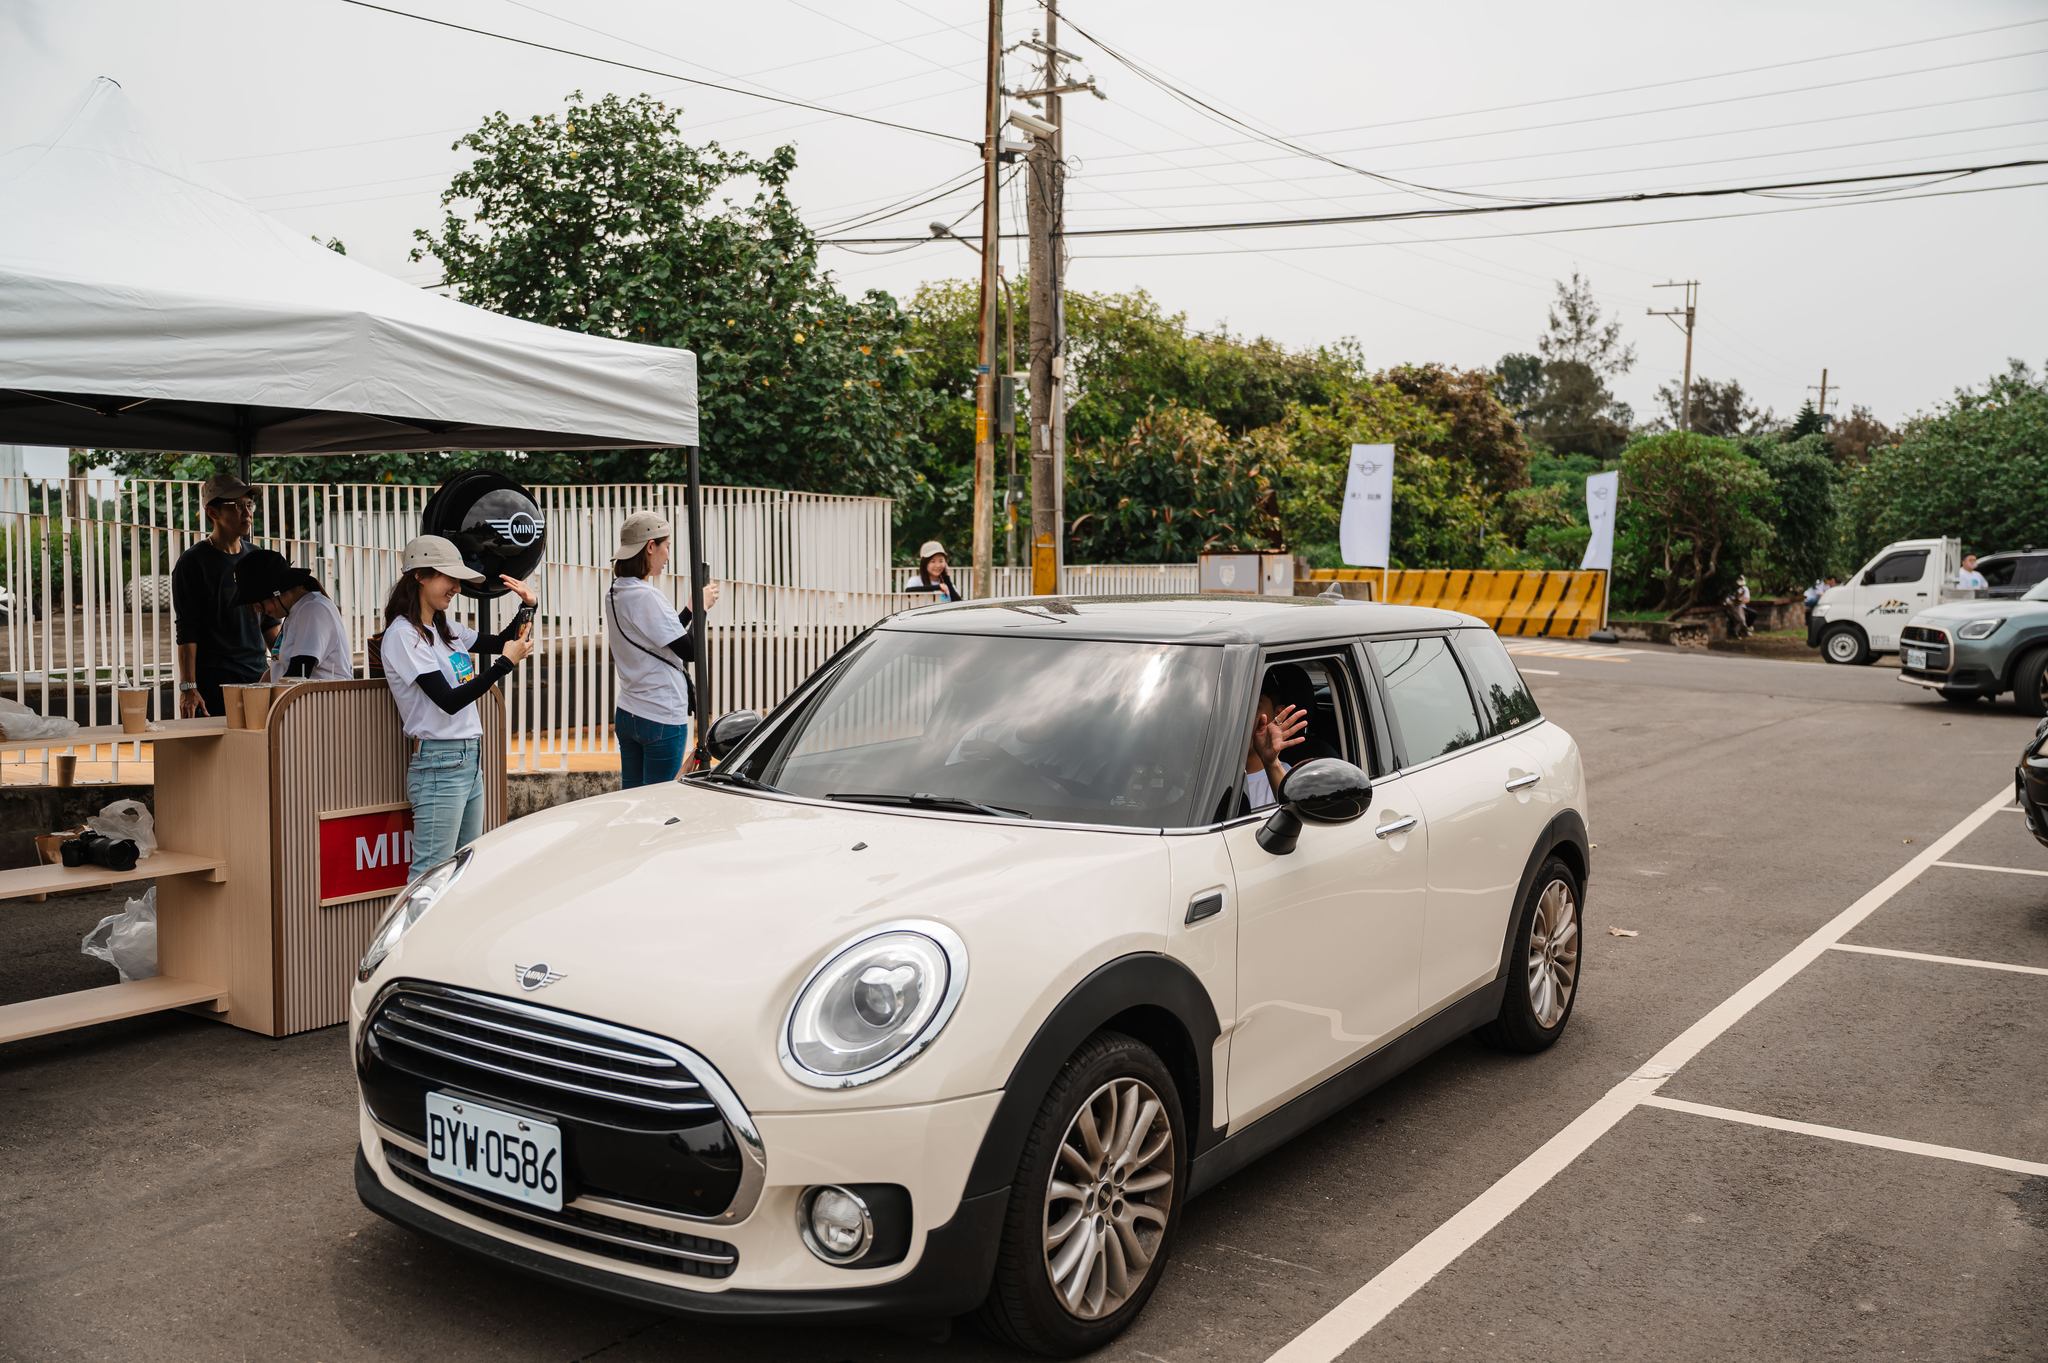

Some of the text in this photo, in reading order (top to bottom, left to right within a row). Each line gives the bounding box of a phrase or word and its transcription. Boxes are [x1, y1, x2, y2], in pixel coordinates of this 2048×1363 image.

[512, 524, 534, 534] MINI
[525, 970, 546, 981] MINI
[429, 1112, 558, 1195] BYW-0586
